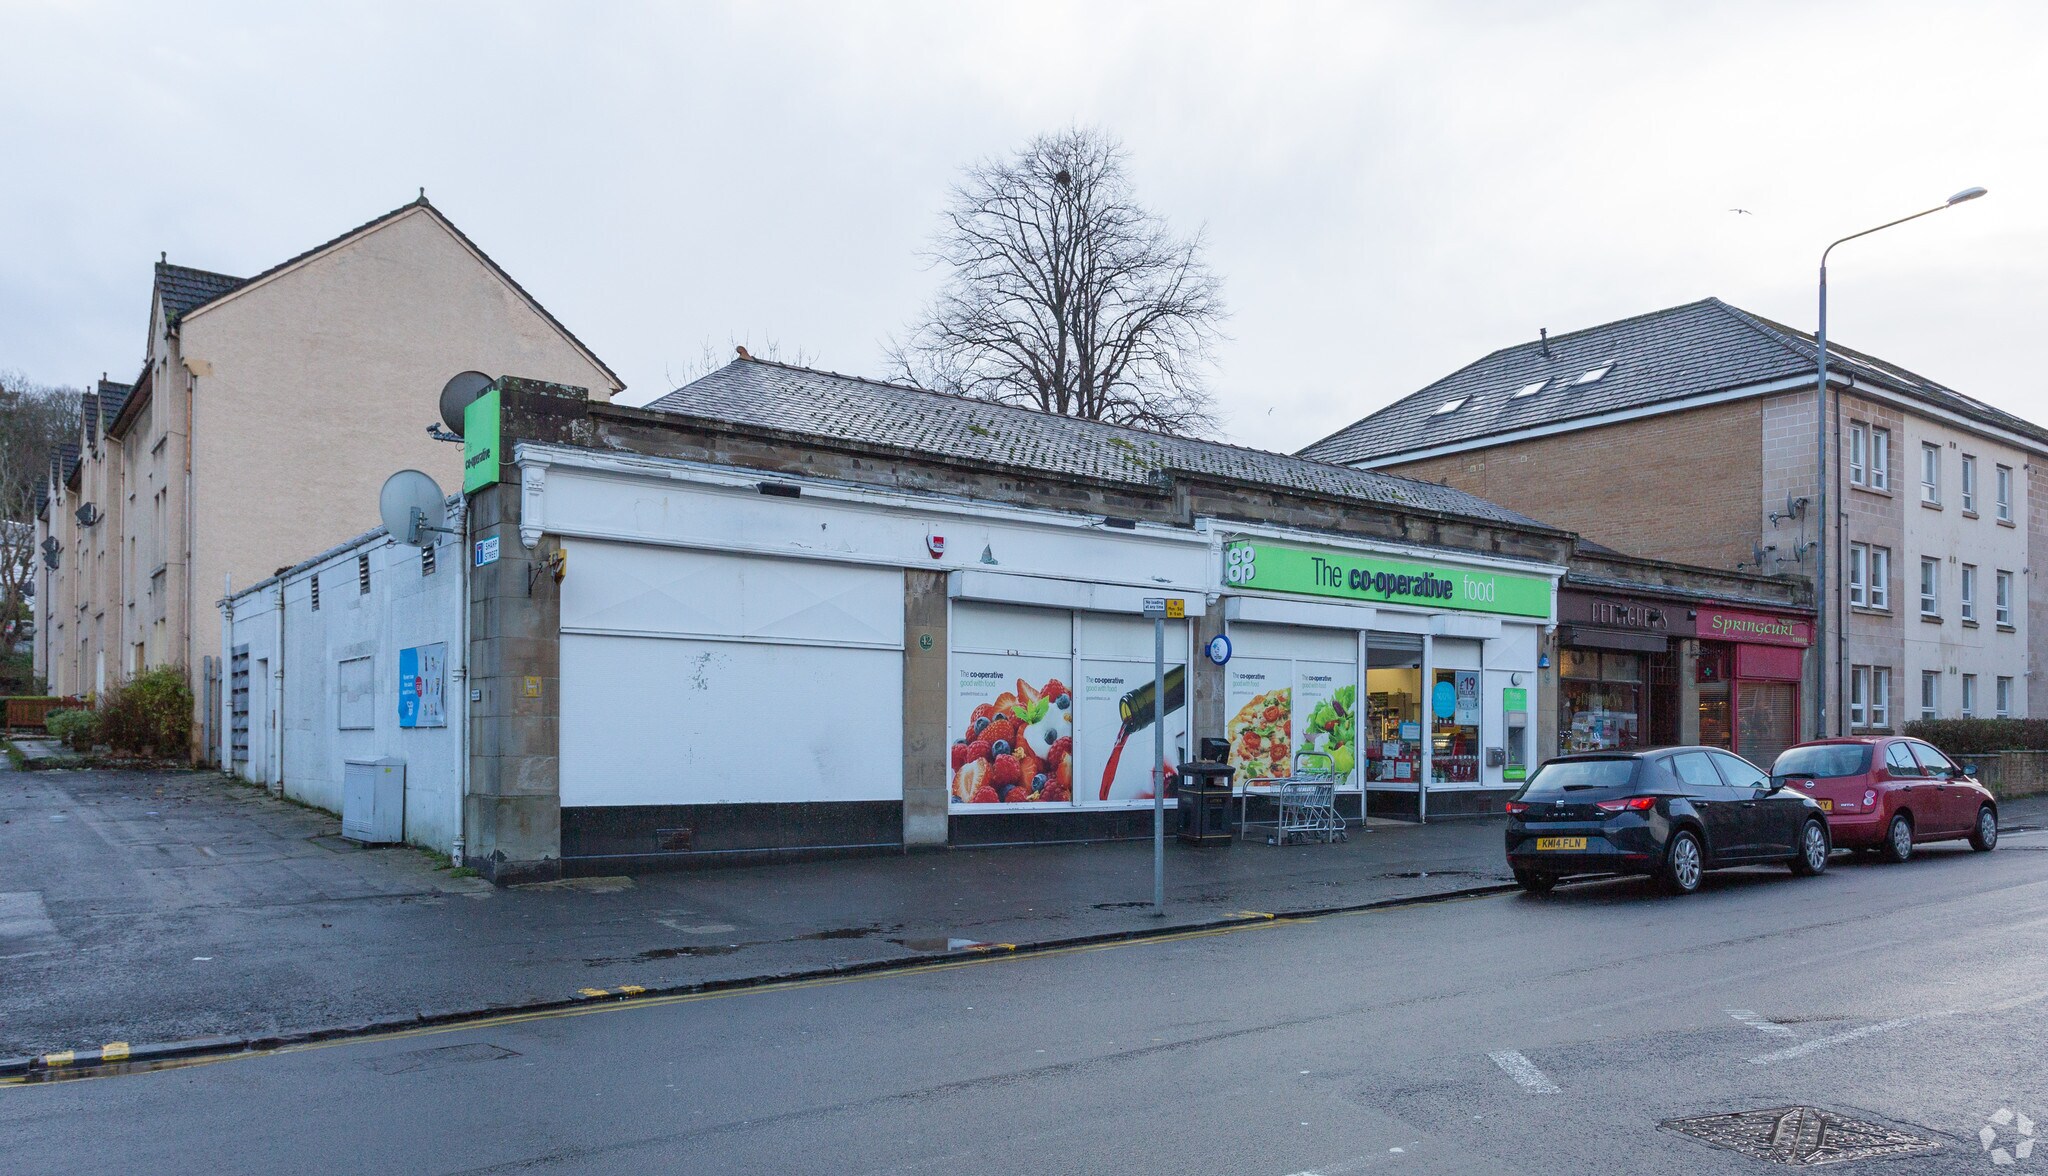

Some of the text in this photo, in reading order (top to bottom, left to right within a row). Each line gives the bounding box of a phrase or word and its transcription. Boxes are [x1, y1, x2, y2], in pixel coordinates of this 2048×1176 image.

[465, 447, 491, 470] co-operative
[485, 539, 498, 551] SHARP
[484, 549, 498, 562] STREET
[1311, 557, 1495, 602] The co-operative food
[921, 636, 932, 645] 42
[970, 671, 1004, 679] co-operative
[1460, 677, 1476, 690] £19
[1542, 839, 1580, 848] KM14 FLN
